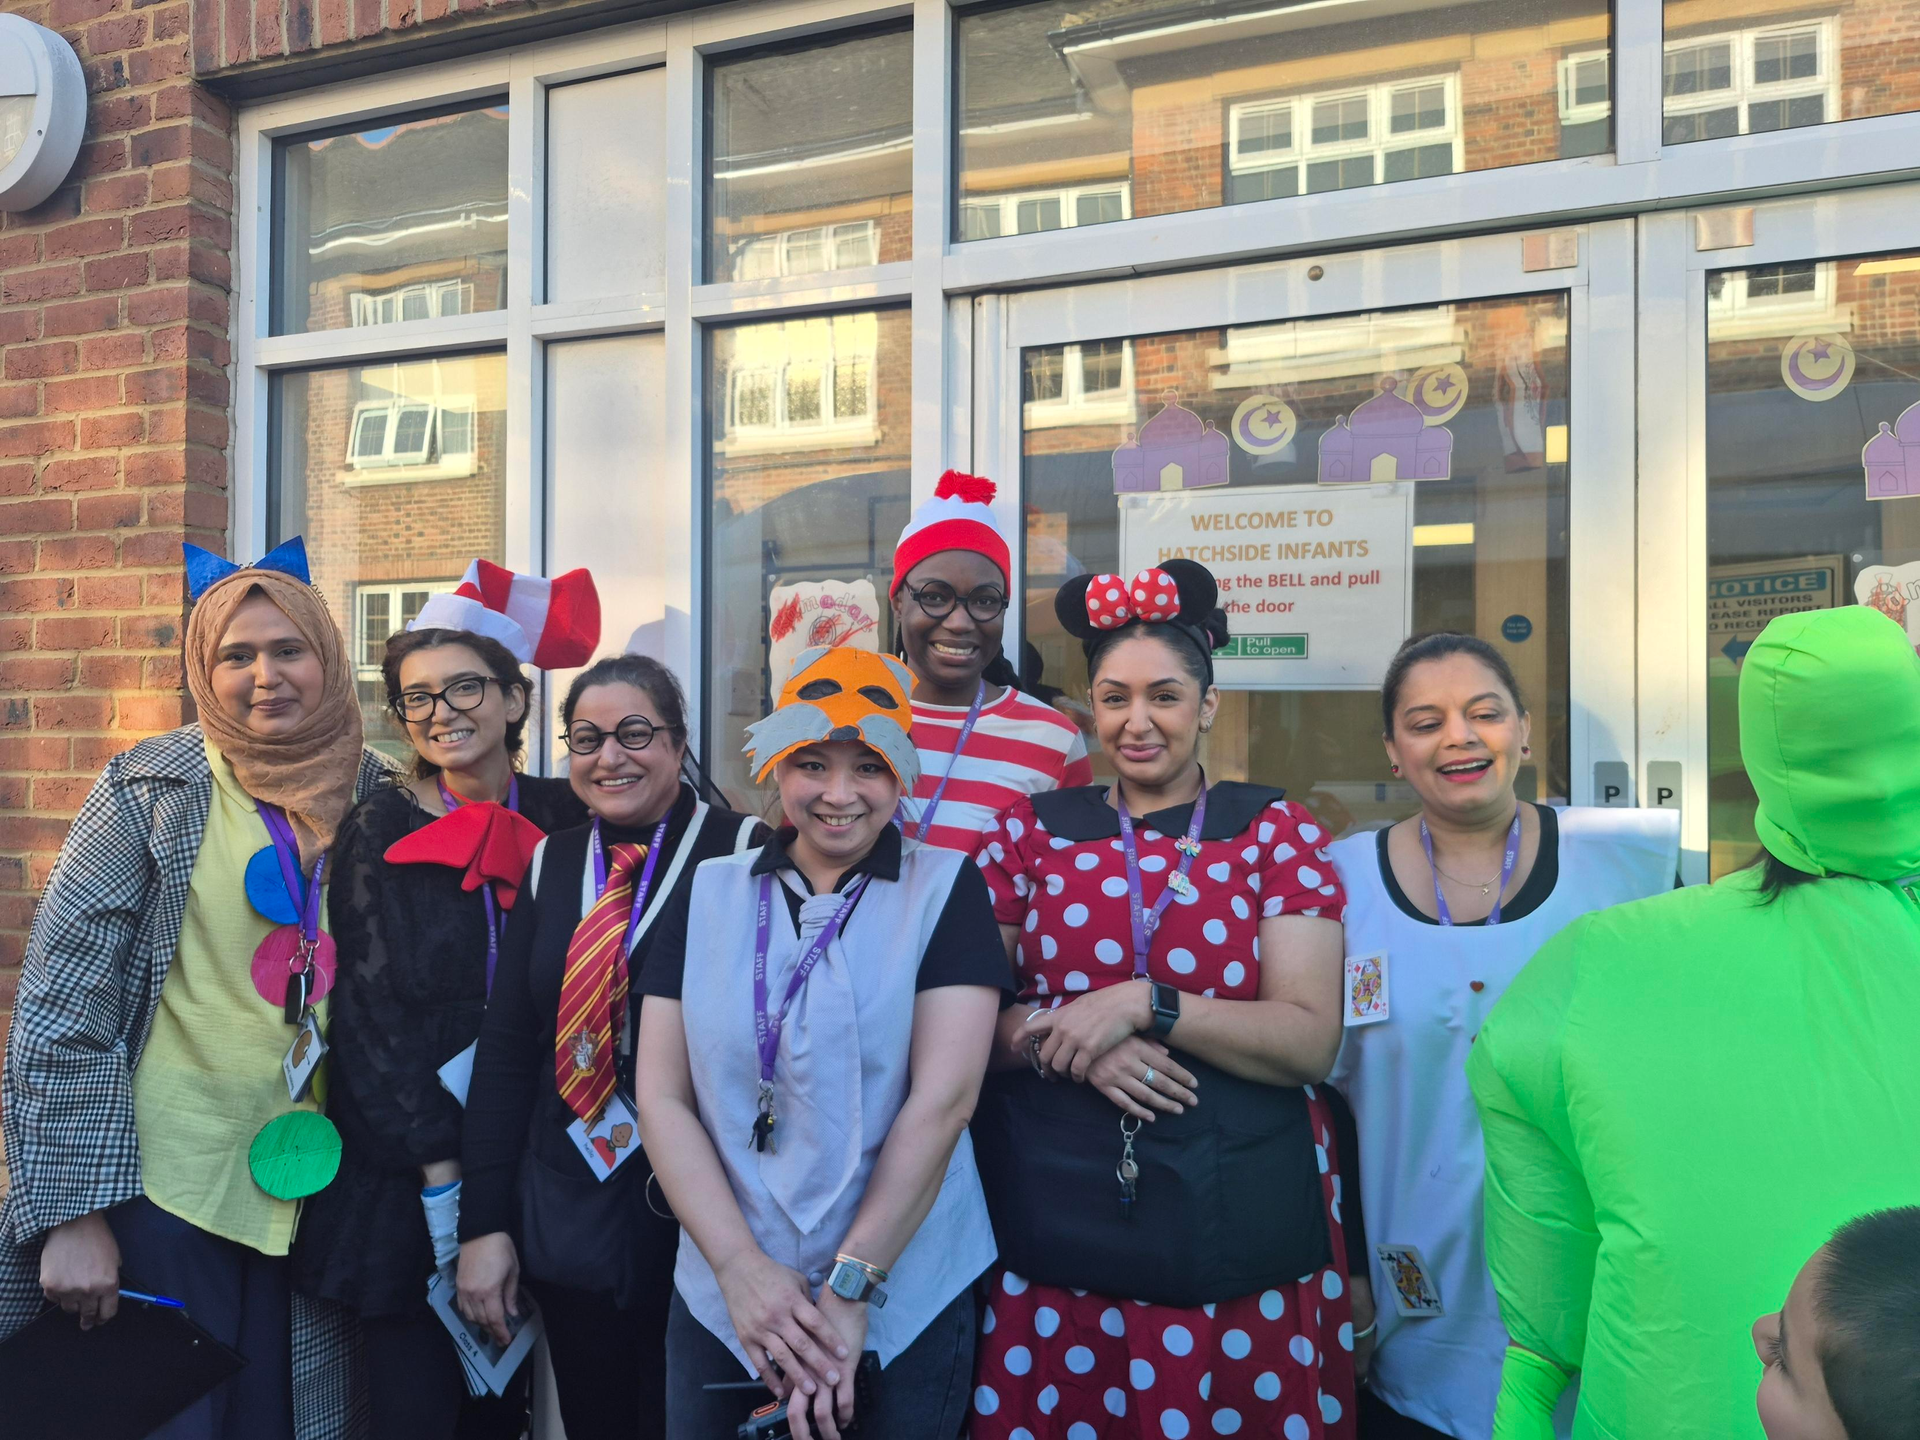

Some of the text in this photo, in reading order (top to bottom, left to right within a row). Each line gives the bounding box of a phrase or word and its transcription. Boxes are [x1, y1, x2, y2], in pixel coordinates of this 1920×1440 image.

[1191, 509, 1333, 531] WELCOME TO
[1158, 540, 1369, 563] HATCHSIDE INFANTS
[1236, 574, 1262, 588] the
[1268, 573, 1305, 587] BELL
[1310, 571, 1342, 586] and
[1348, 570, 1380, 588] pull
[1224, 599, 1294, 613] the door
[1737, 594, 1813, 607] VISITORS
[1711, 609, 1752, 620] EASE
[1246, 645, 1296, 656] to open
[1247, 637, 1270, 646] Pull
[1604, 785, 1620, 803] P
[1657, 787, 1673, 805] P
[635, 823, 667, 908] STAFF STAFF
[1179, 858, 1188, 875] AFF
[1504, 850, 1515, 869] STAFF
[1122, 816, 1142, 923] STAFF STAFF STAFF
[834, 898, 854, 924] STAFF
[1144, 904, 1161, 936] STAFF
[800, 946, 822, 977] STAFF
[755, 900, 768, 1044] STAFF STAFF STAFF
